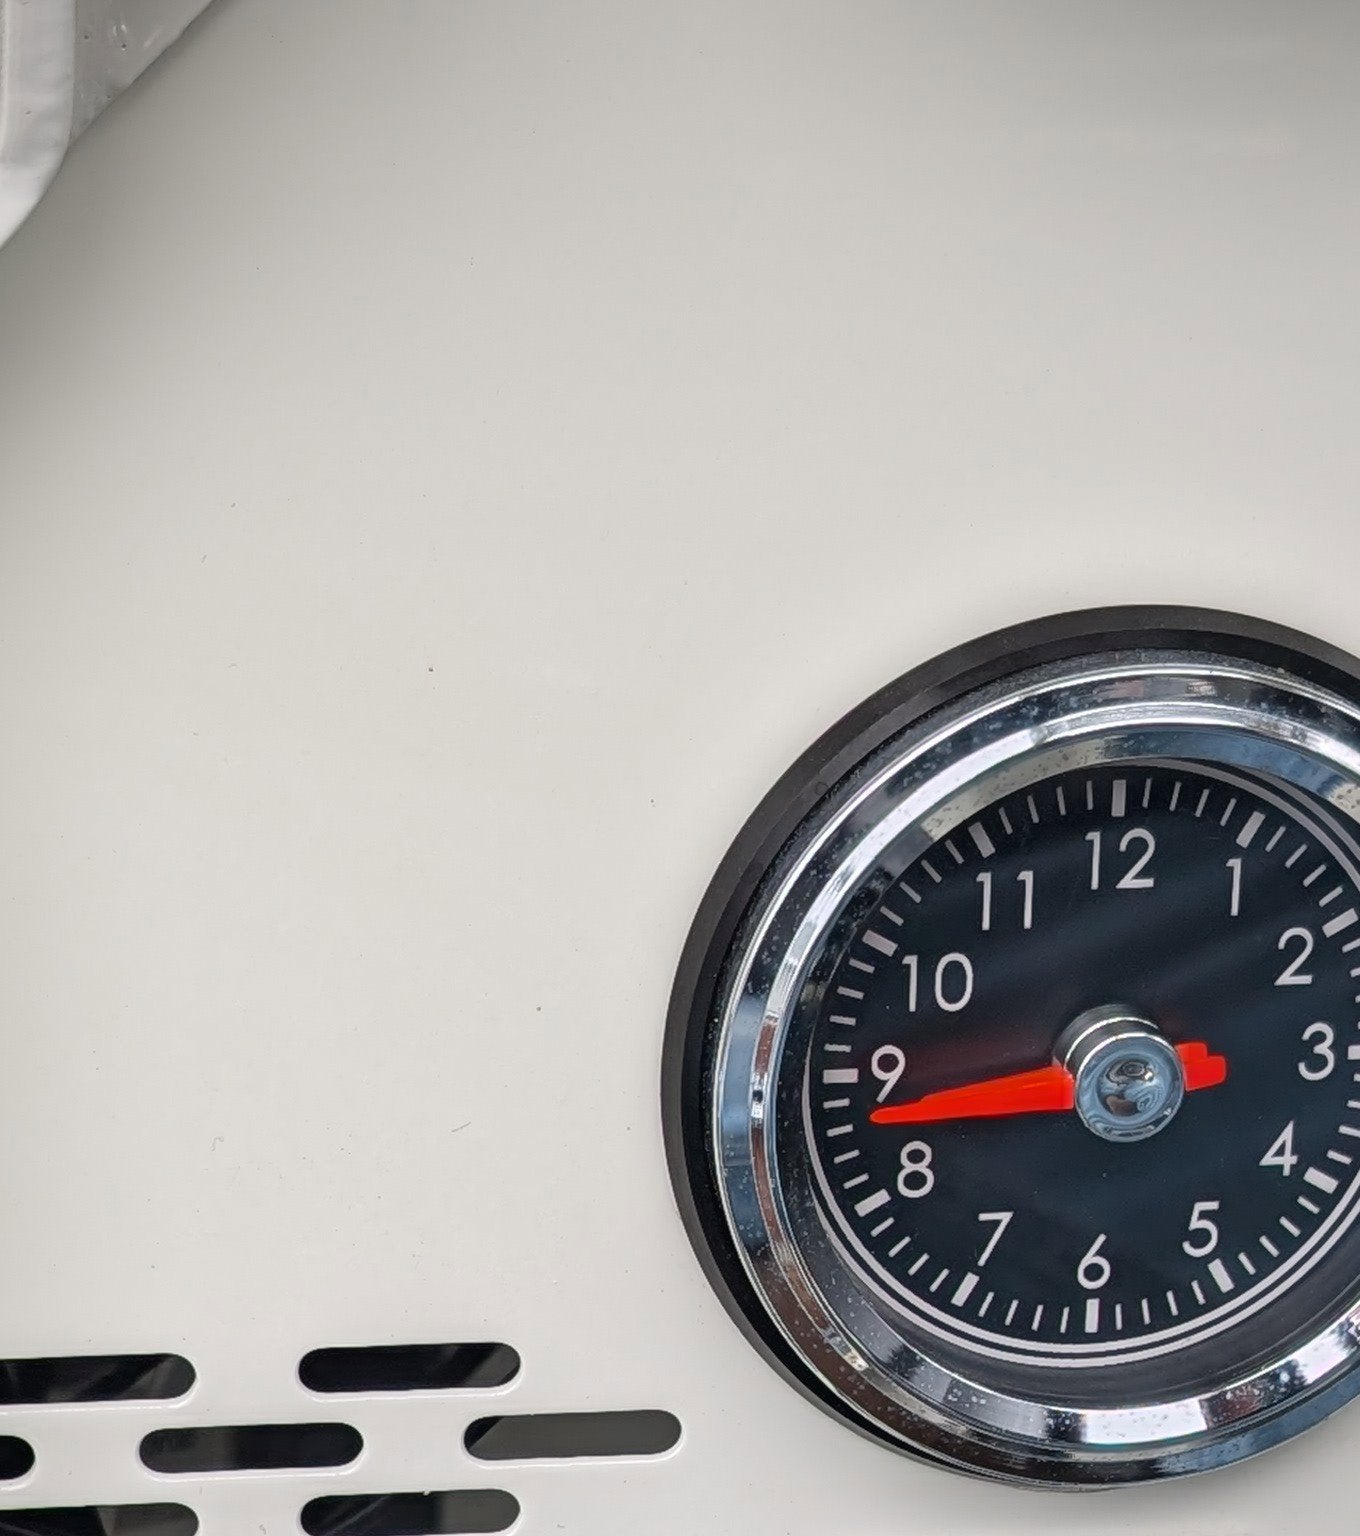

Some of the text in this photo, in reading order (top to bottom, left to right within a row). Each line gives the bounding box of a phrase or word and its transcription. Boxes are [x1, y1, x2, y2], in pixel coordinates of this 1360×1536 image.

[1085, 827, 1156, 890] 12
[1225, 857, 1242, 917] 1
[976, 870, 1034, 931] 11
[901, 952, 974, 1012] 10
[1273, 926, 1314, 986] 2
[871, 1044, 906, 1103] 9
[1298, 1021, 1335, 1081] 3
[897, 1140, 935, 1199] 8
[1259, 1120, 1299, 1177] 4
[977, 1211, 1014, 1267] 7
[1182, 1200, 1220, 1258] 5
[1077, 1233, 1111, 1290] 6
